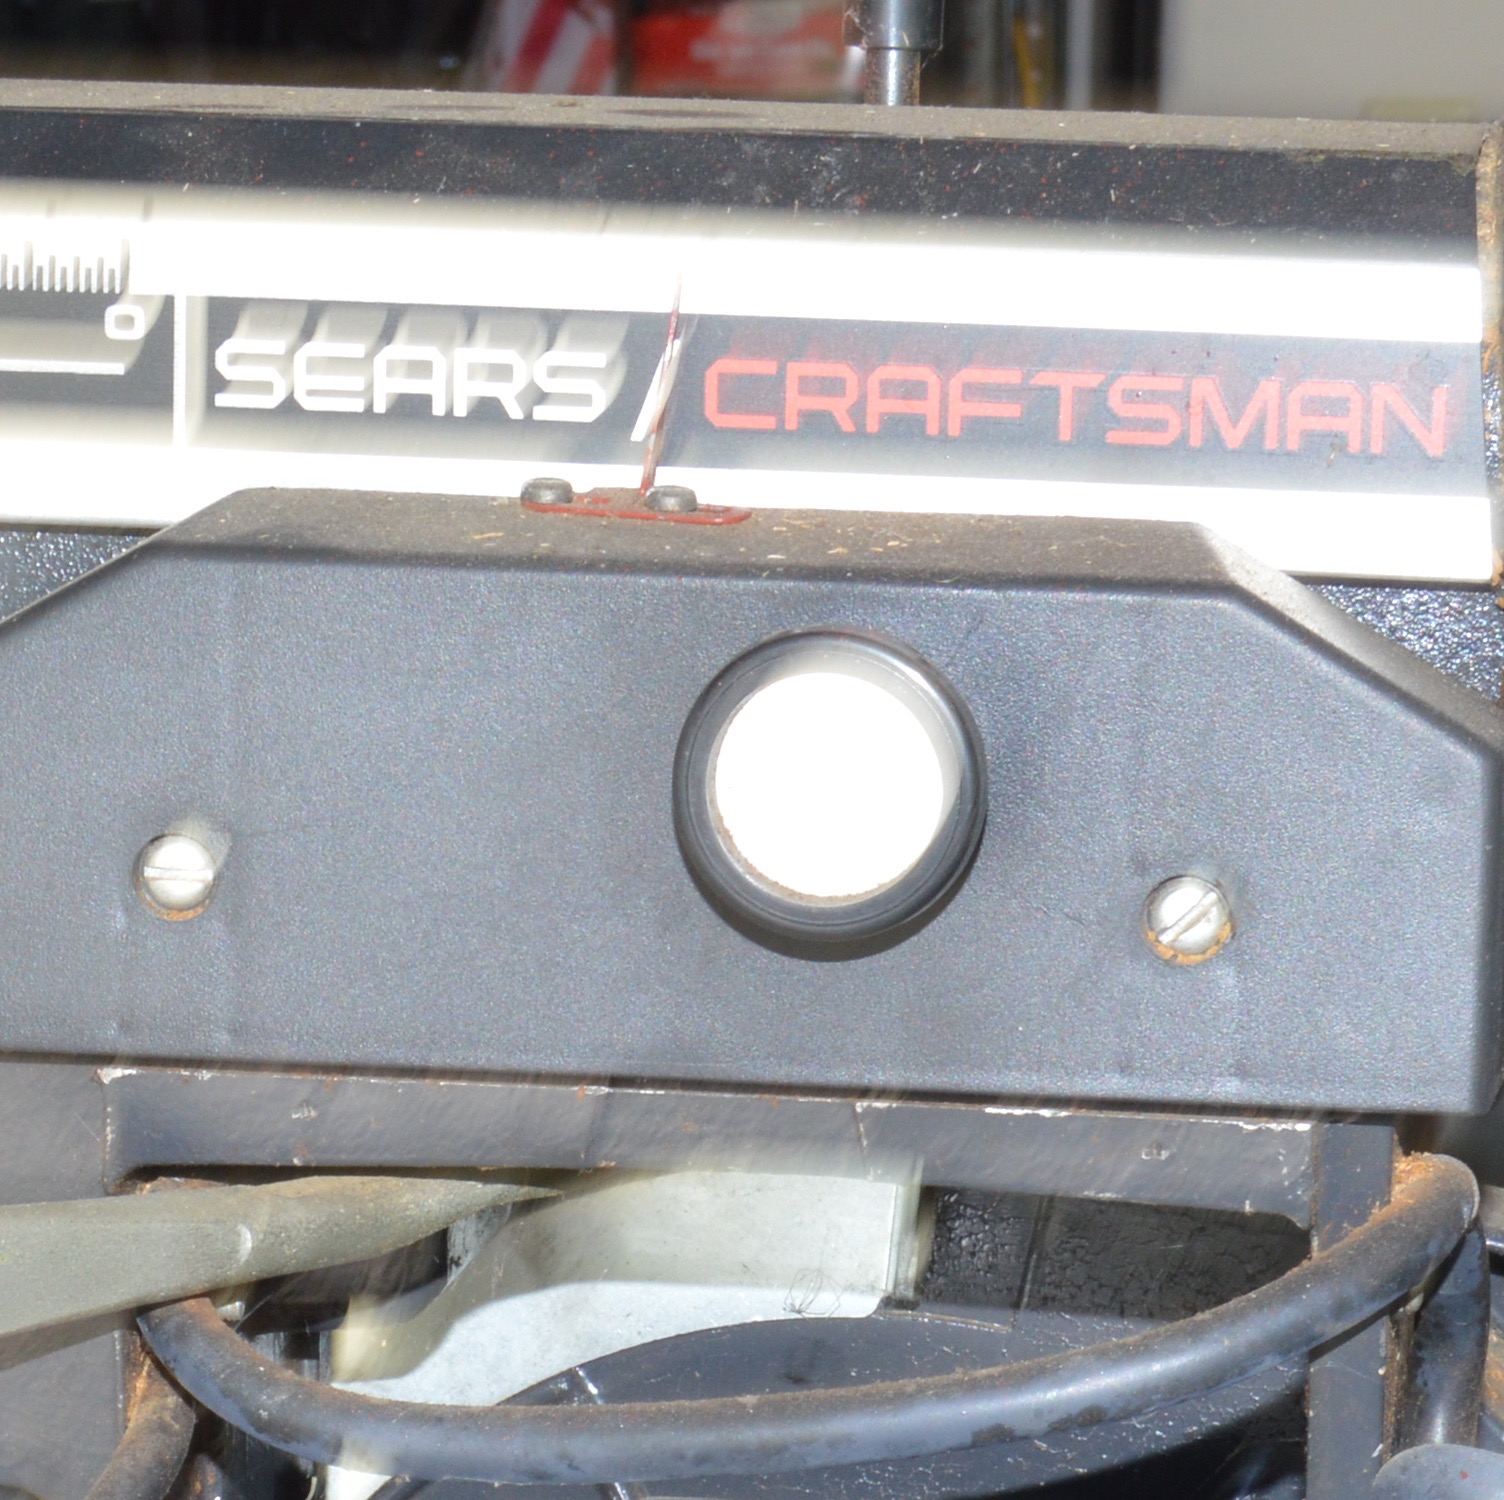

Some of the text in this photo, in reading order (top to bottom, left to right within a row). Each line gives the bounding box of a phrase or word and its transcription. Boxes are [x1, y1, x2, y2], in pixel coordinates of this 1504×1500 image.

[104, 304, 146, 340] 0
[214, 338, 607, 423] SEARS
[703, 356, 1449, 459] CRAFTSMAN
